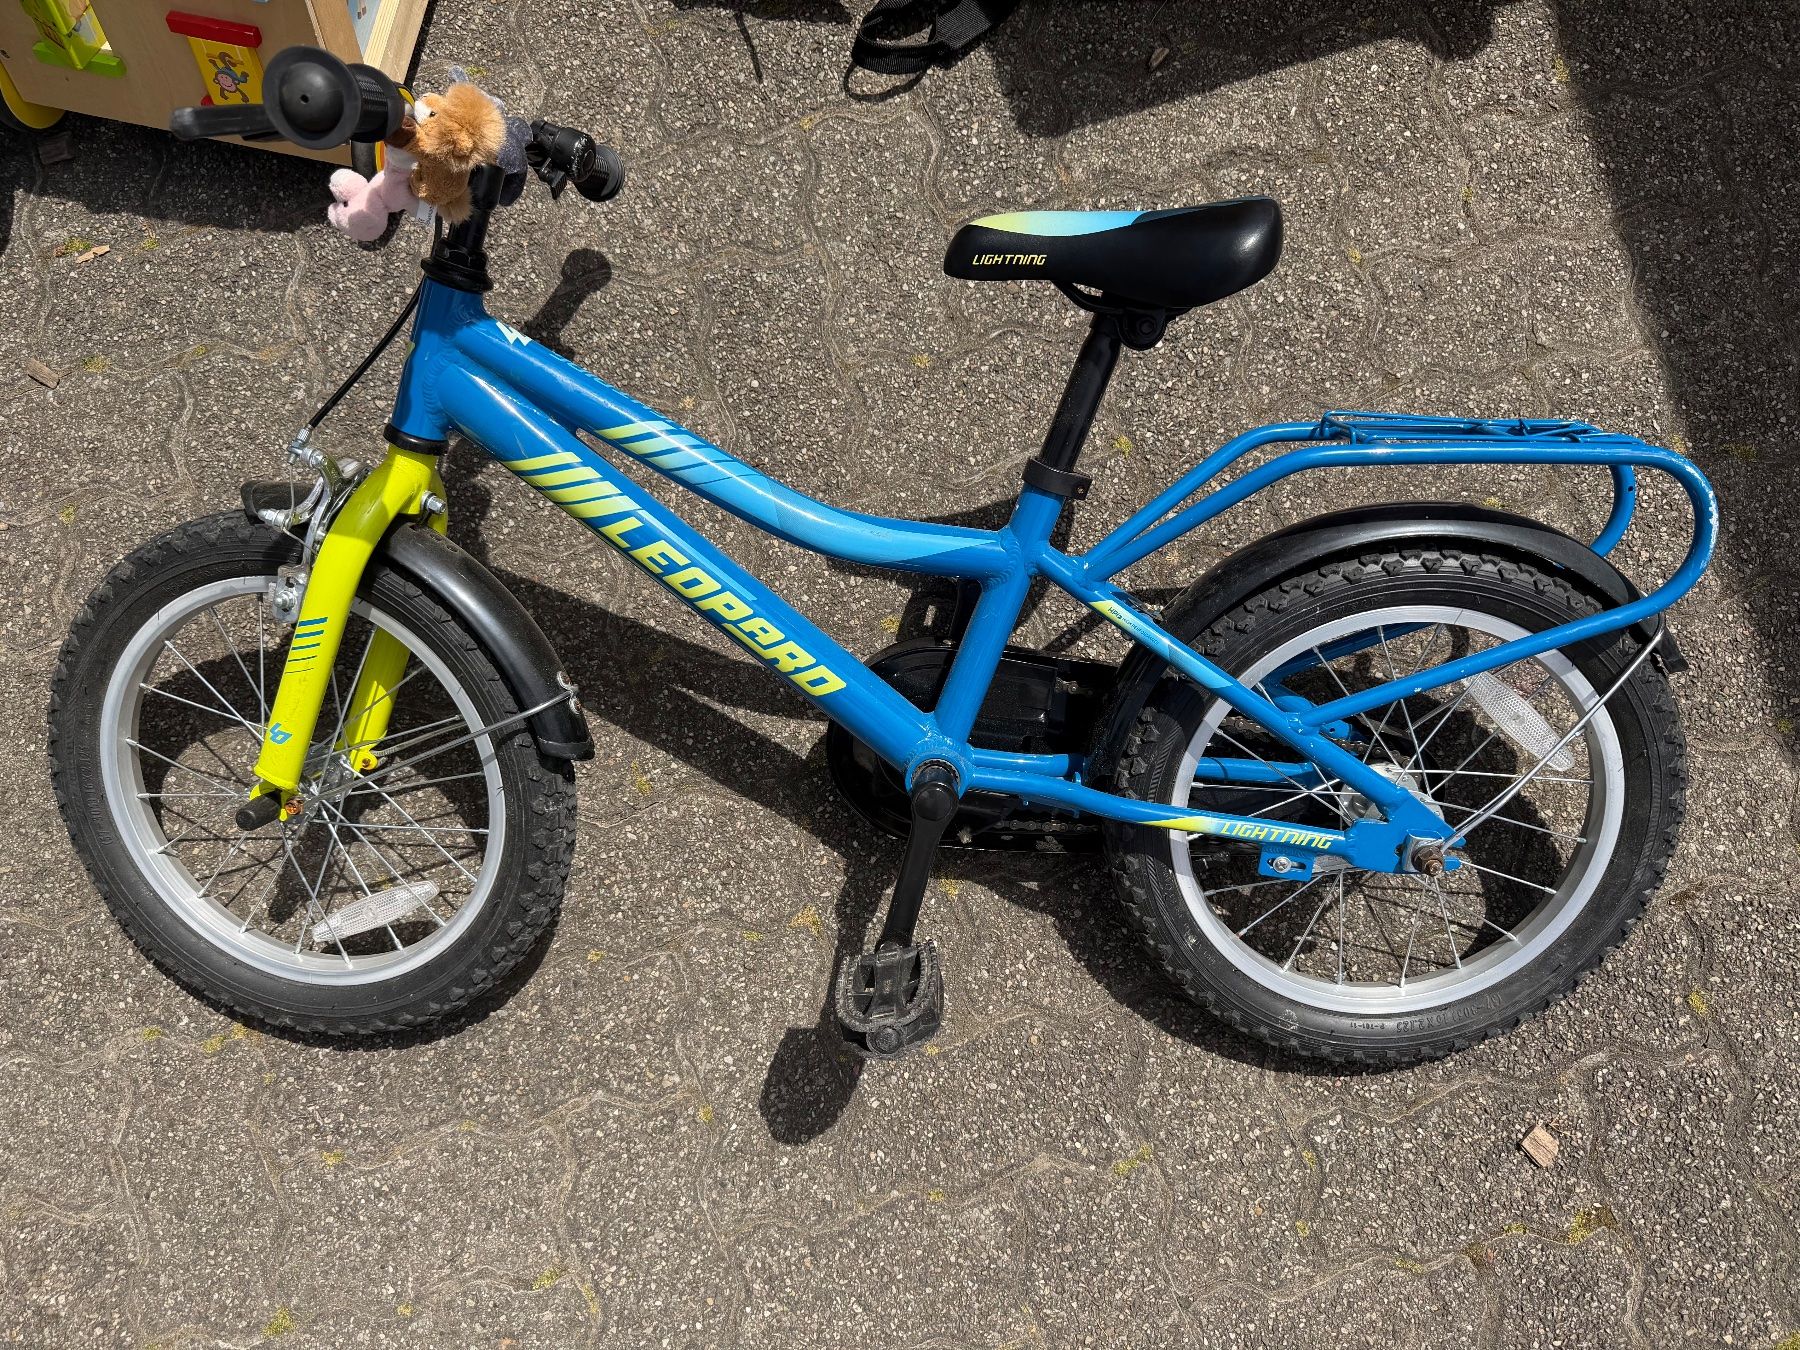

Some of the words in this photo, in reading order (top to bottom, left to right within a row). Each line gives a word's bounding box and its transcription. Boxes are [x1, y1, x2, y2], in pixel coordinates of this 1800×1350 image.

[972, 254, 1048, 266] LIGHTNING
[600, 517, 846, 697] LEOPARD
[1220, 822, 1334, 850] LIGHTNING
